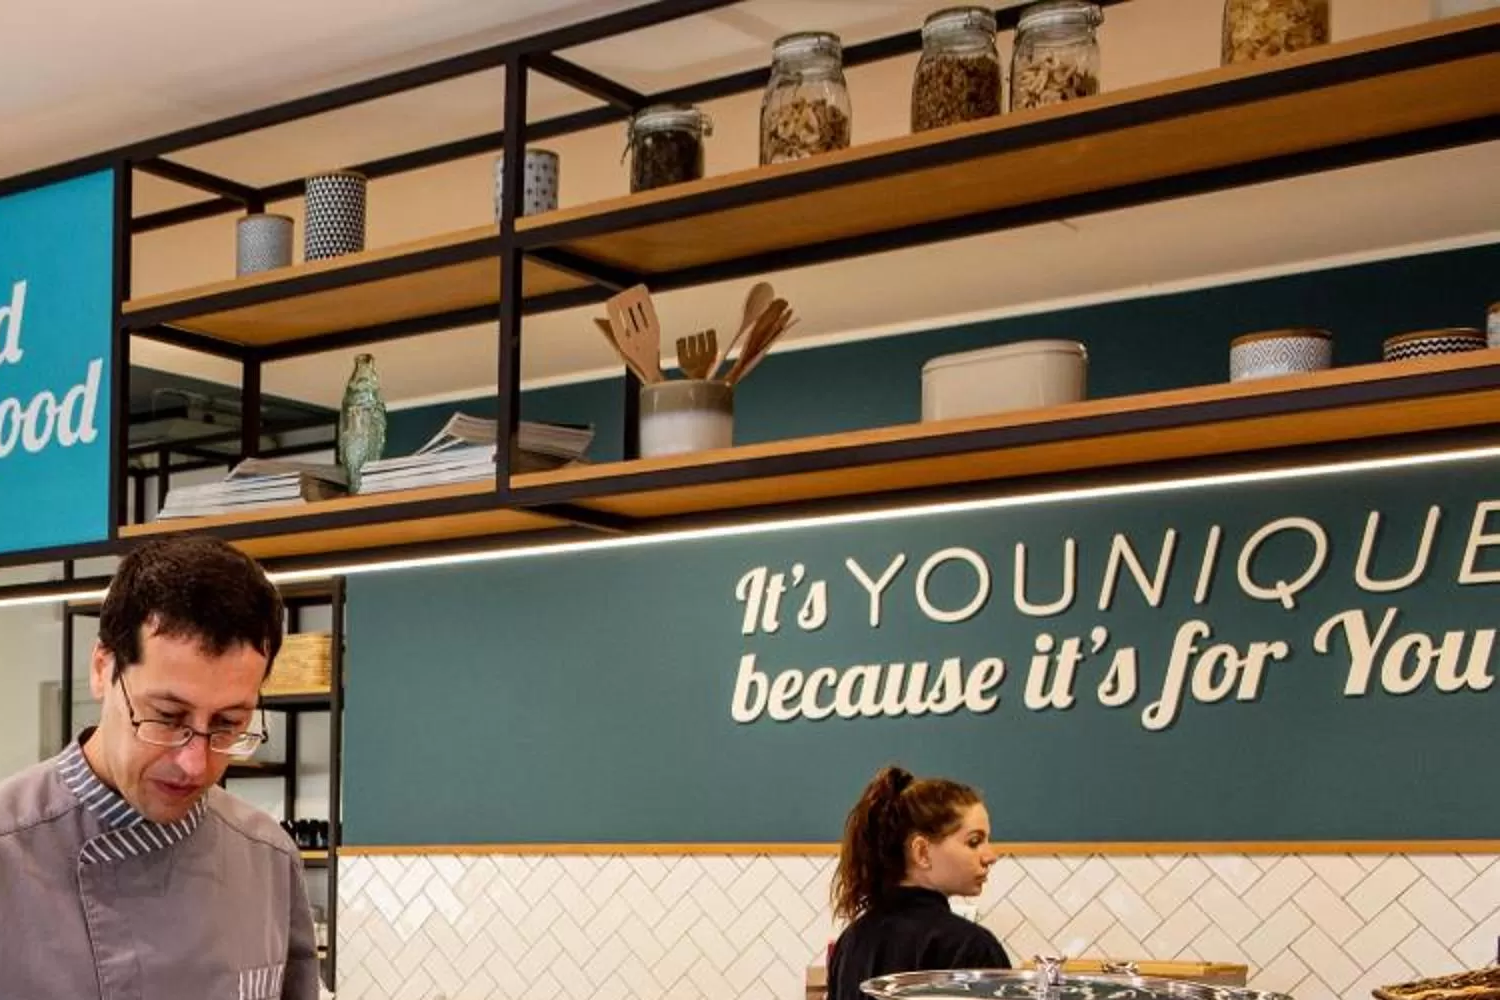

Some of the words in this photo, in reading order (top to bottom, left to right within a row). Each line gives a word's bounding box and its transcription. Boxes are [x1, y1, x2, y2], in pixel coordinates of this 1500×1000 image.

[734, 562, 828, 635] It's
[845, 499, 1500, 626] YOUNIQUE
[730, 653, 1005, 723] because
[1024, 625, 1138, 710] it's
[1141, 619, 1290, 731] for
[1313, 607, 1497, 696] You
